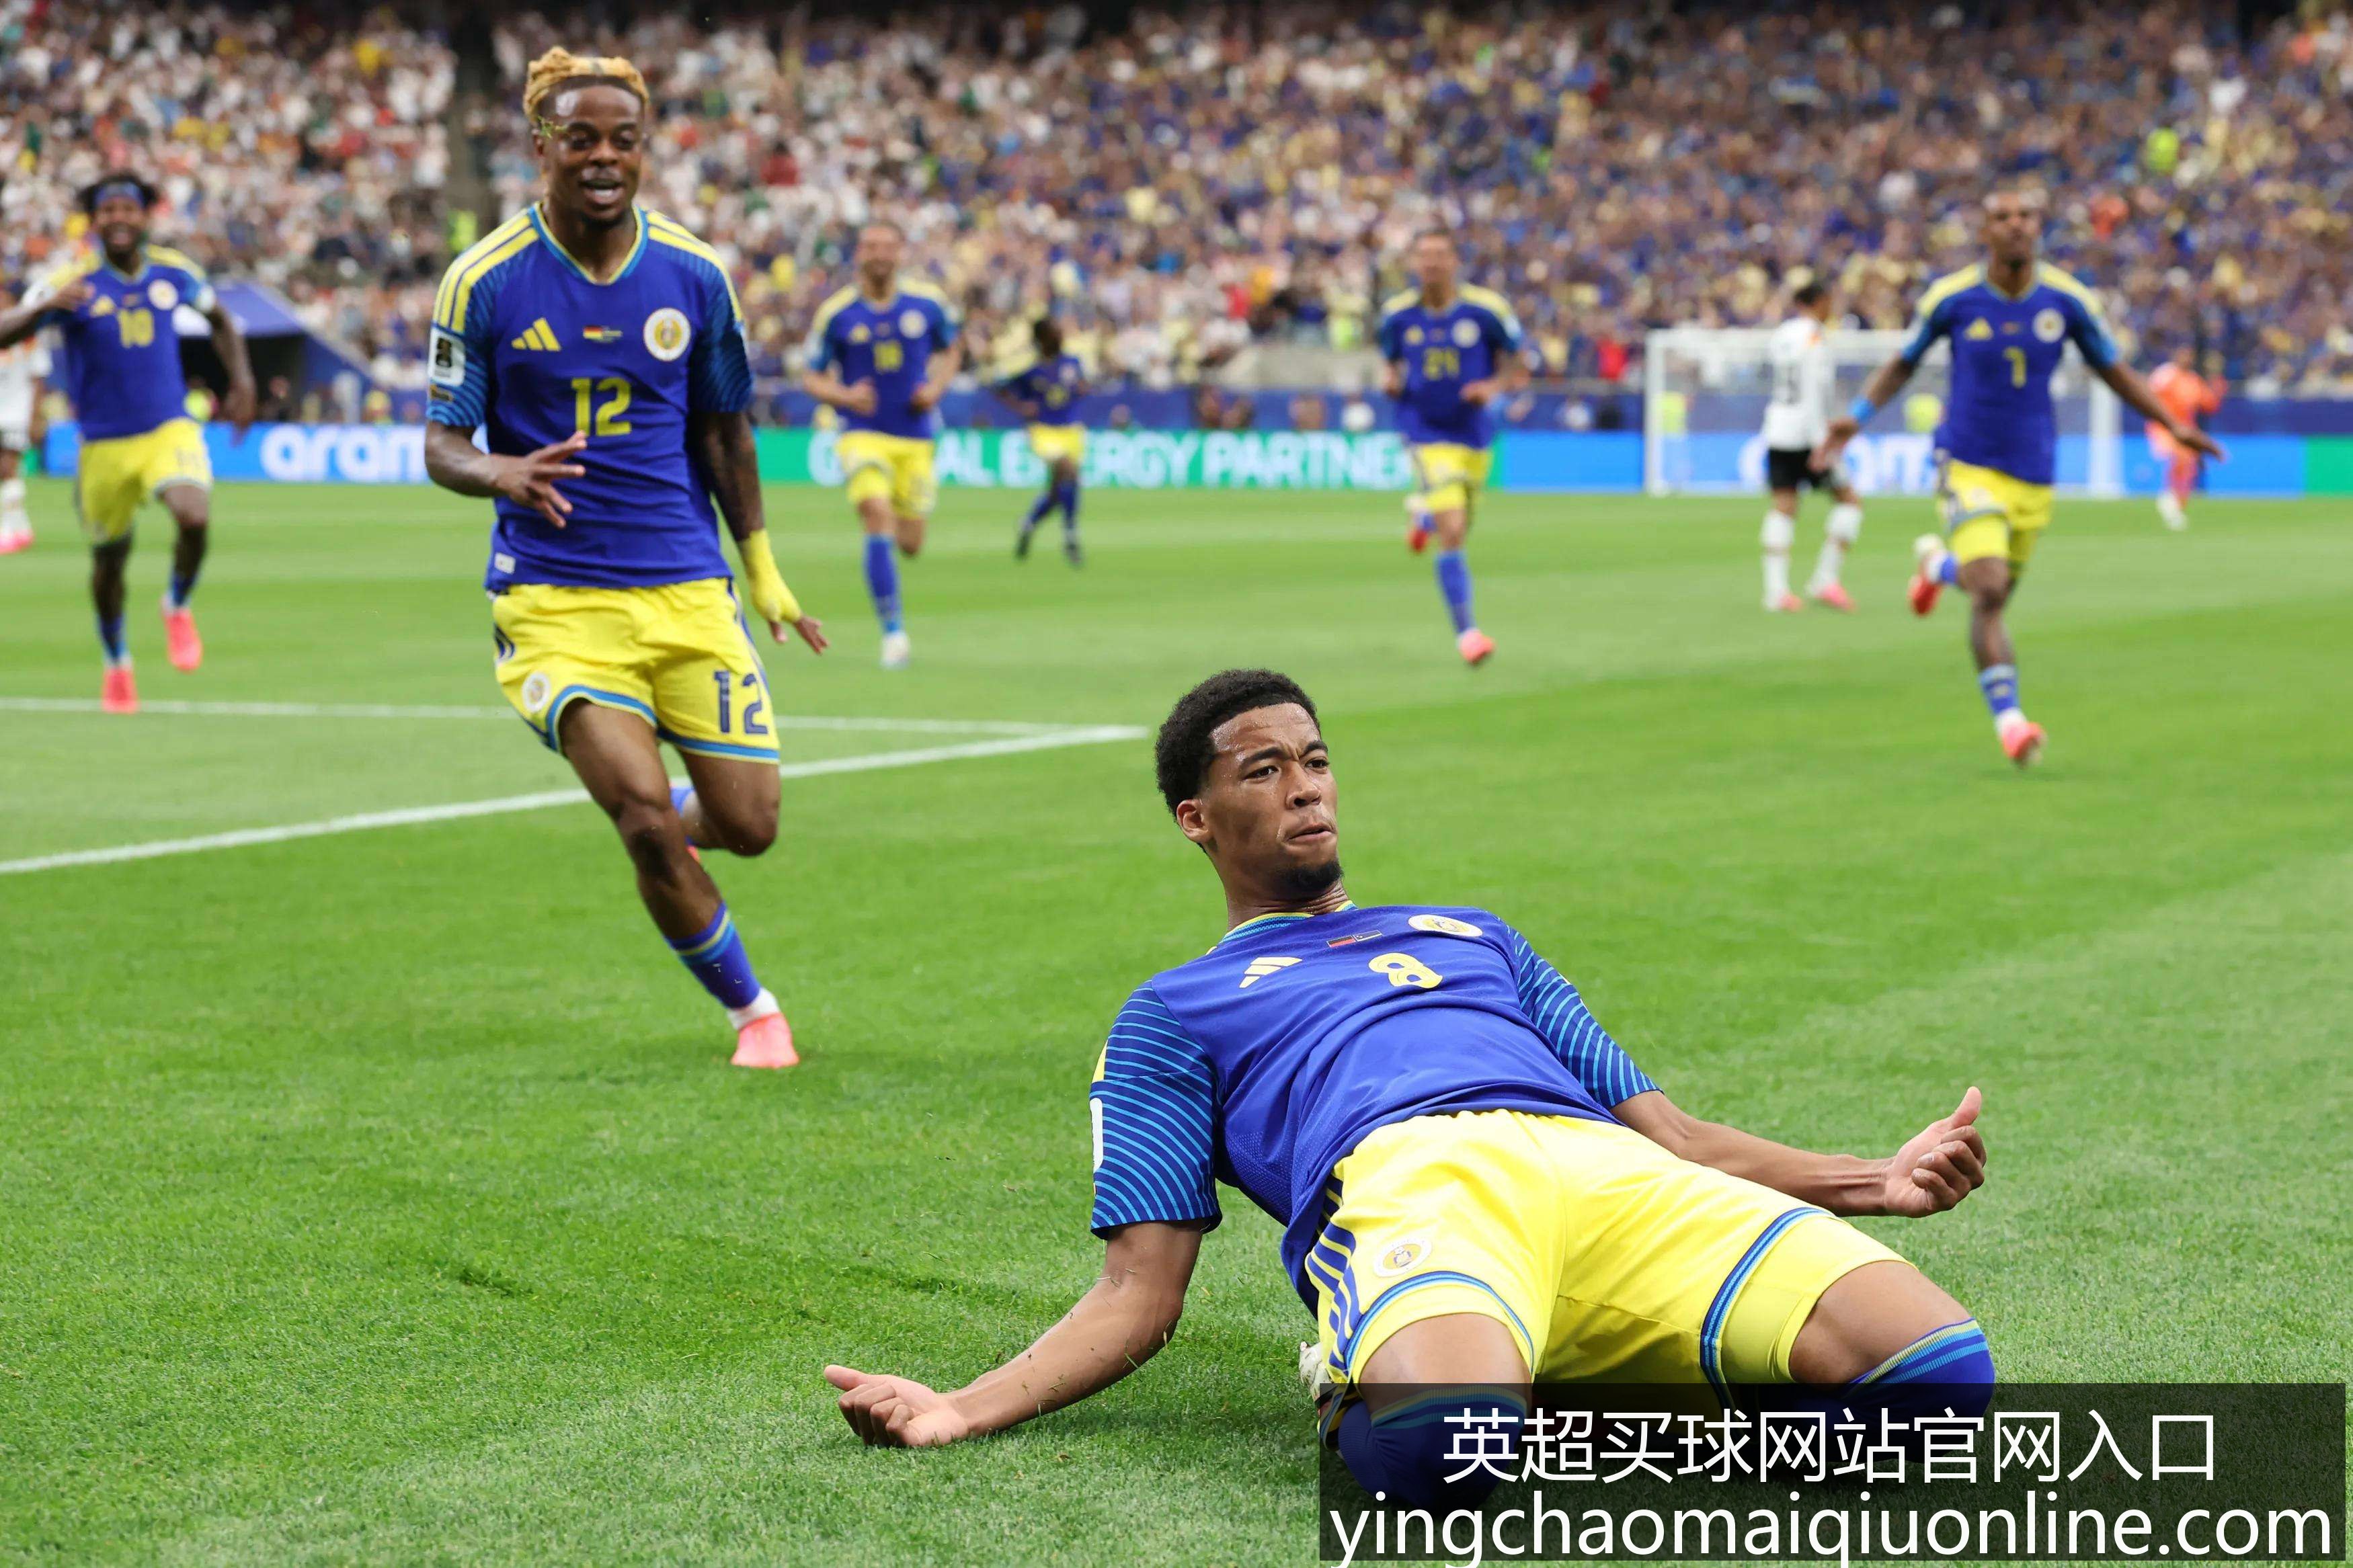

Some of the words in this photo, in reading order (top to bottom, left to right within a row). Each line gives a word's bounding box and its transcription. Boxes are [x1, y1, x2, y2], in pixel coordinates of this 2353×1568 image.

[571, 378, 631, 437] 12
[1203, 429, 1411, 489] PARTNE
[713, 670, 768, 734] 12
[1368, 952, 1443, 989] 8
